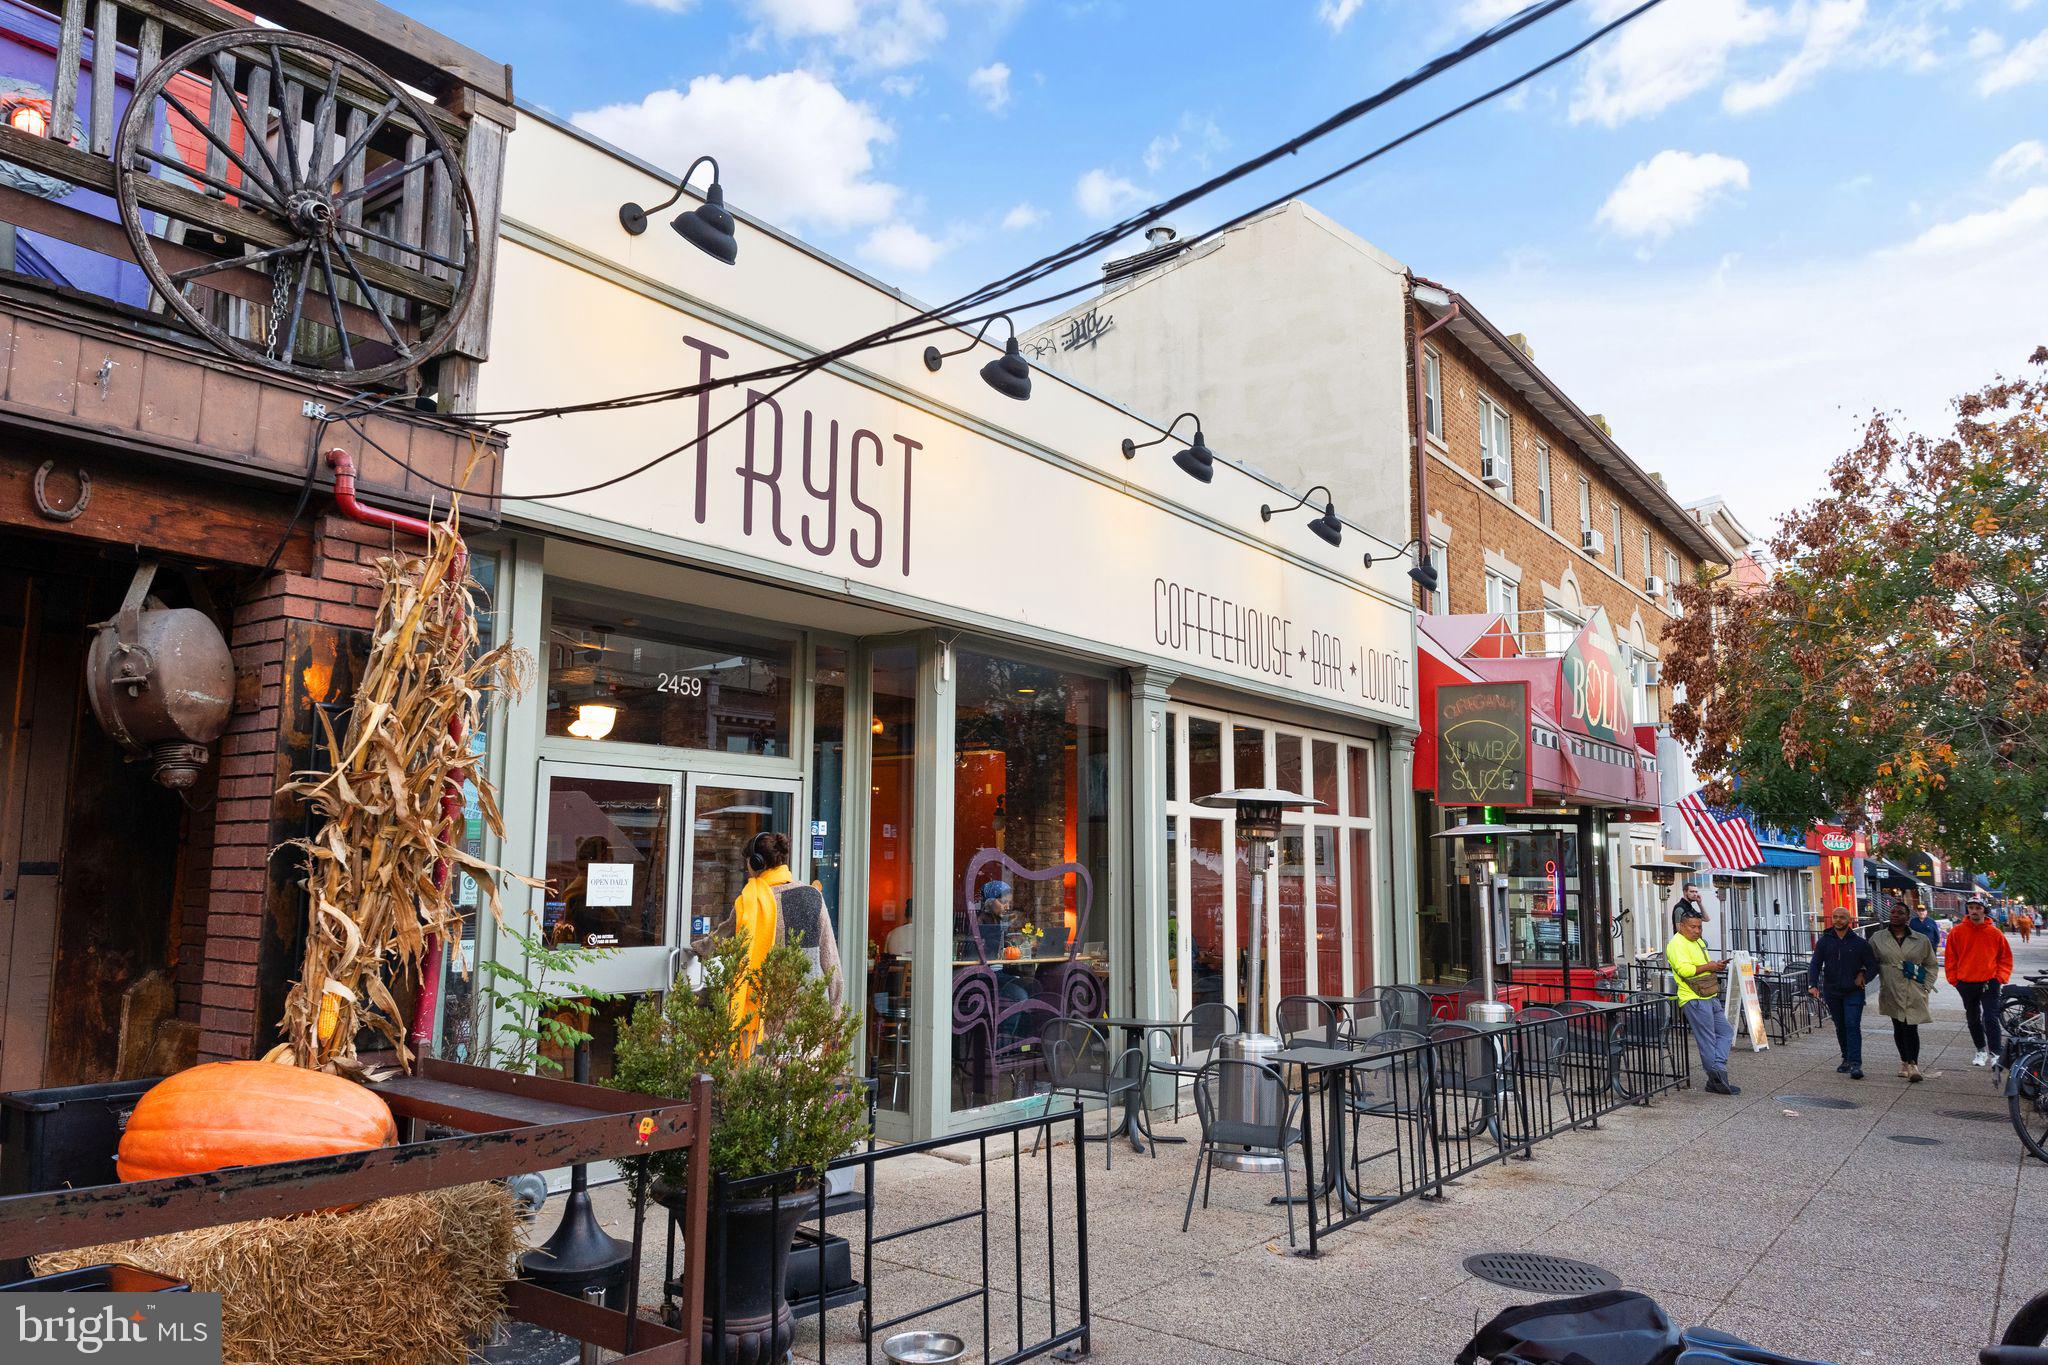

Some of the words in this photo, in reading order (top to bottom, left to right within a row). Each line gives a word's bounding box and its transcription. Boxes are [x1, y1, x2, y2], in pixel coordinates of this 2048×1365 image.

[682, 335, 923, 576] TRYST
[1154, 577, 1293, 679] COFFEEHOUSE
[1311, 629, 1345, 692] BAR
[1360, 646, 1410, 710] LOUNGE
[657, 672, 702, 697] 2459
[1445, 740, 1523, 761] JUMBO
[1451, 769, 1515, 790] SLICE
[1826, 840, 1850, 849] MART
[1827, 834, 1851, 843] PIZZA
